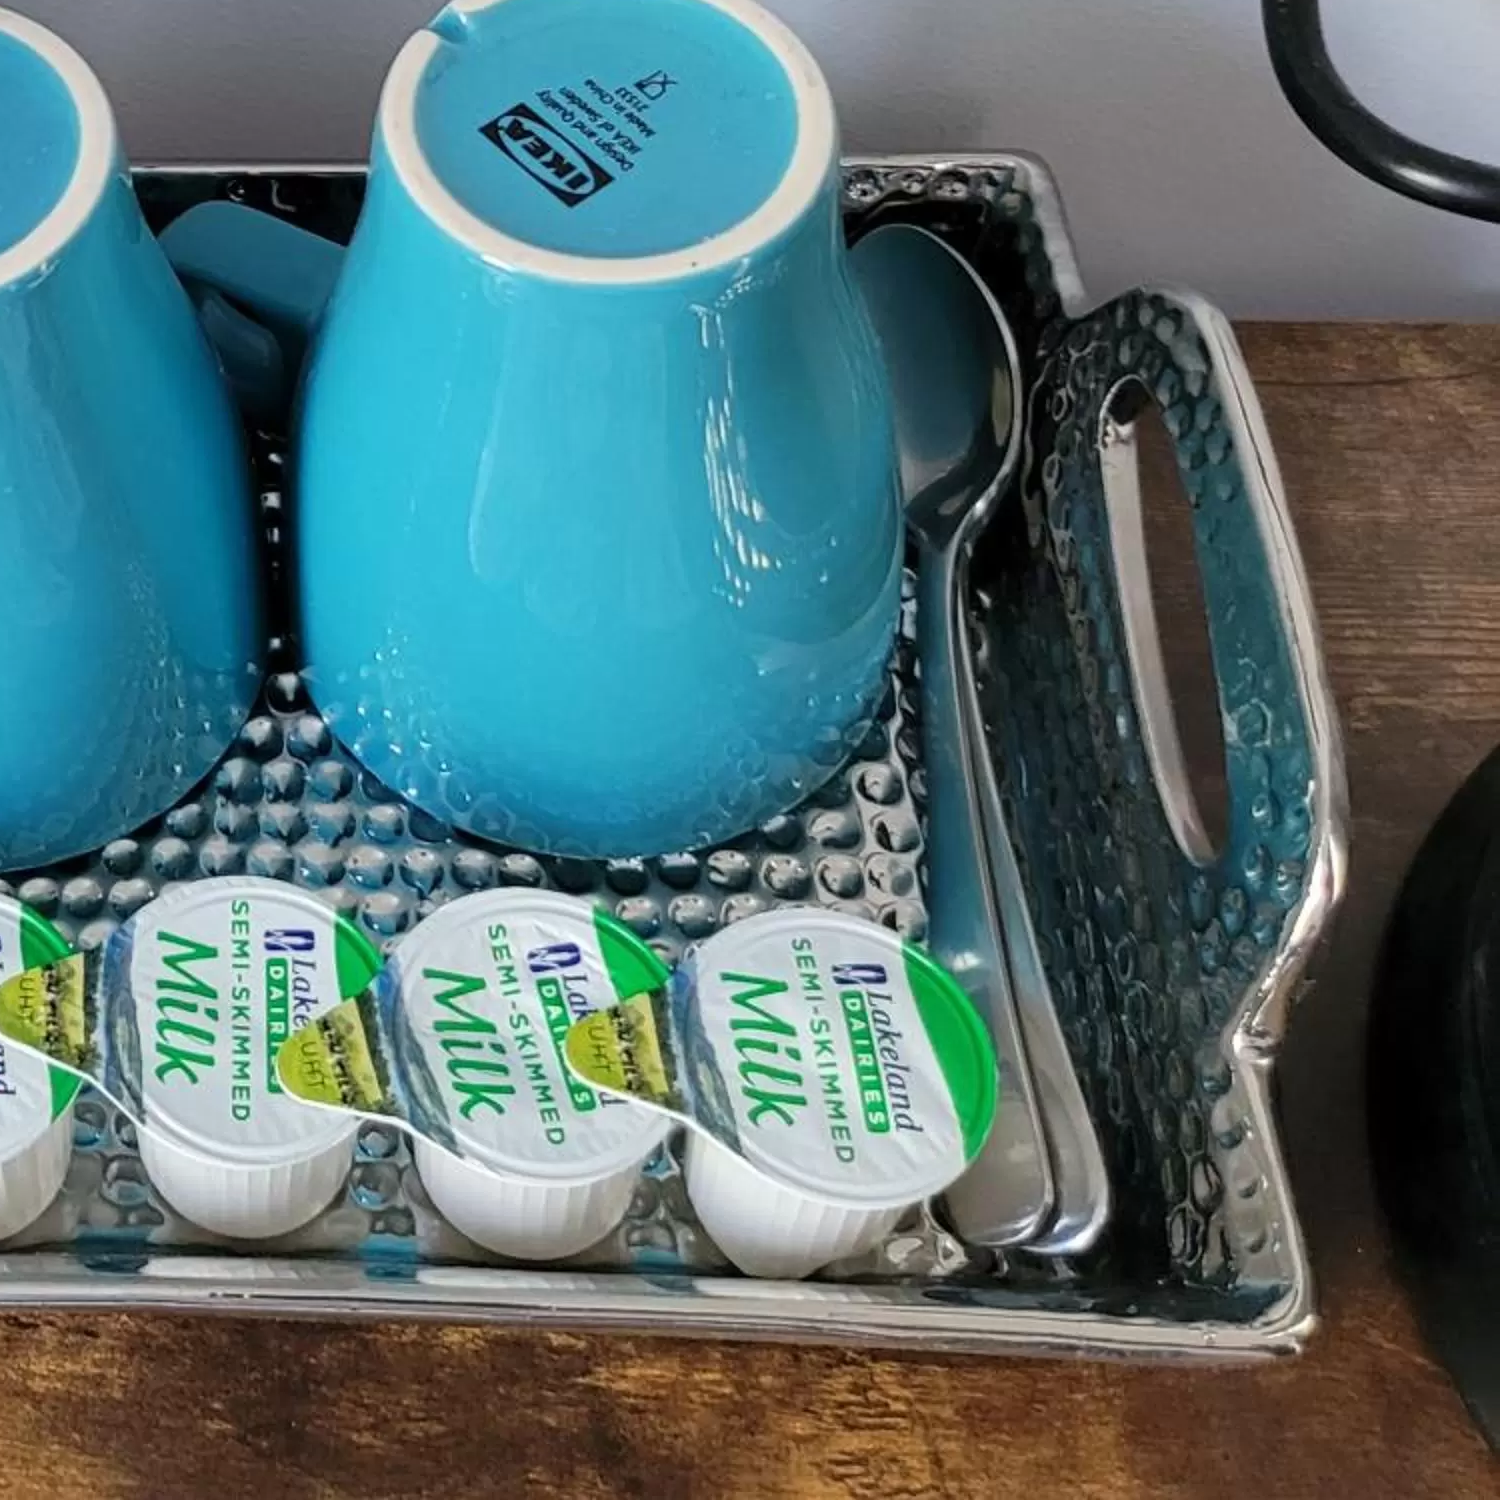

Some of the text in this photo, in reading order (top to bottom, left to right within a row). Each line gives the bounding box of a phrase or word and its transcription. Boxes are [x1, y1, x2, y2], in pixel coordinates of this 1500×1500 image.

[501, 118, 590, 190] IKEA
[535, 90, 634, 171] Design and Quality
[558, 86, 642, 154] IKEA of Sweden
[584, 79, 656, 137] Made in China
[154, 930, 219, 1086] Milk
[231, 899, 251, 1122] SEMI-SKIMMED
[300, 1042, 327, 1089] UHT
[422, 967, 516, 1122] Milk
[488, 923, 565, 1145] SEMI-SKIMMED
[587, 1026, 610, 1073] UHT
[720, 972, 808, 1128] Milk
[792, 938, 855, 1163] SEMI-SKIMMED
[844, 997, 886, 1125] DAIRIES
[867, 990, 923, 1133] Lakeland
